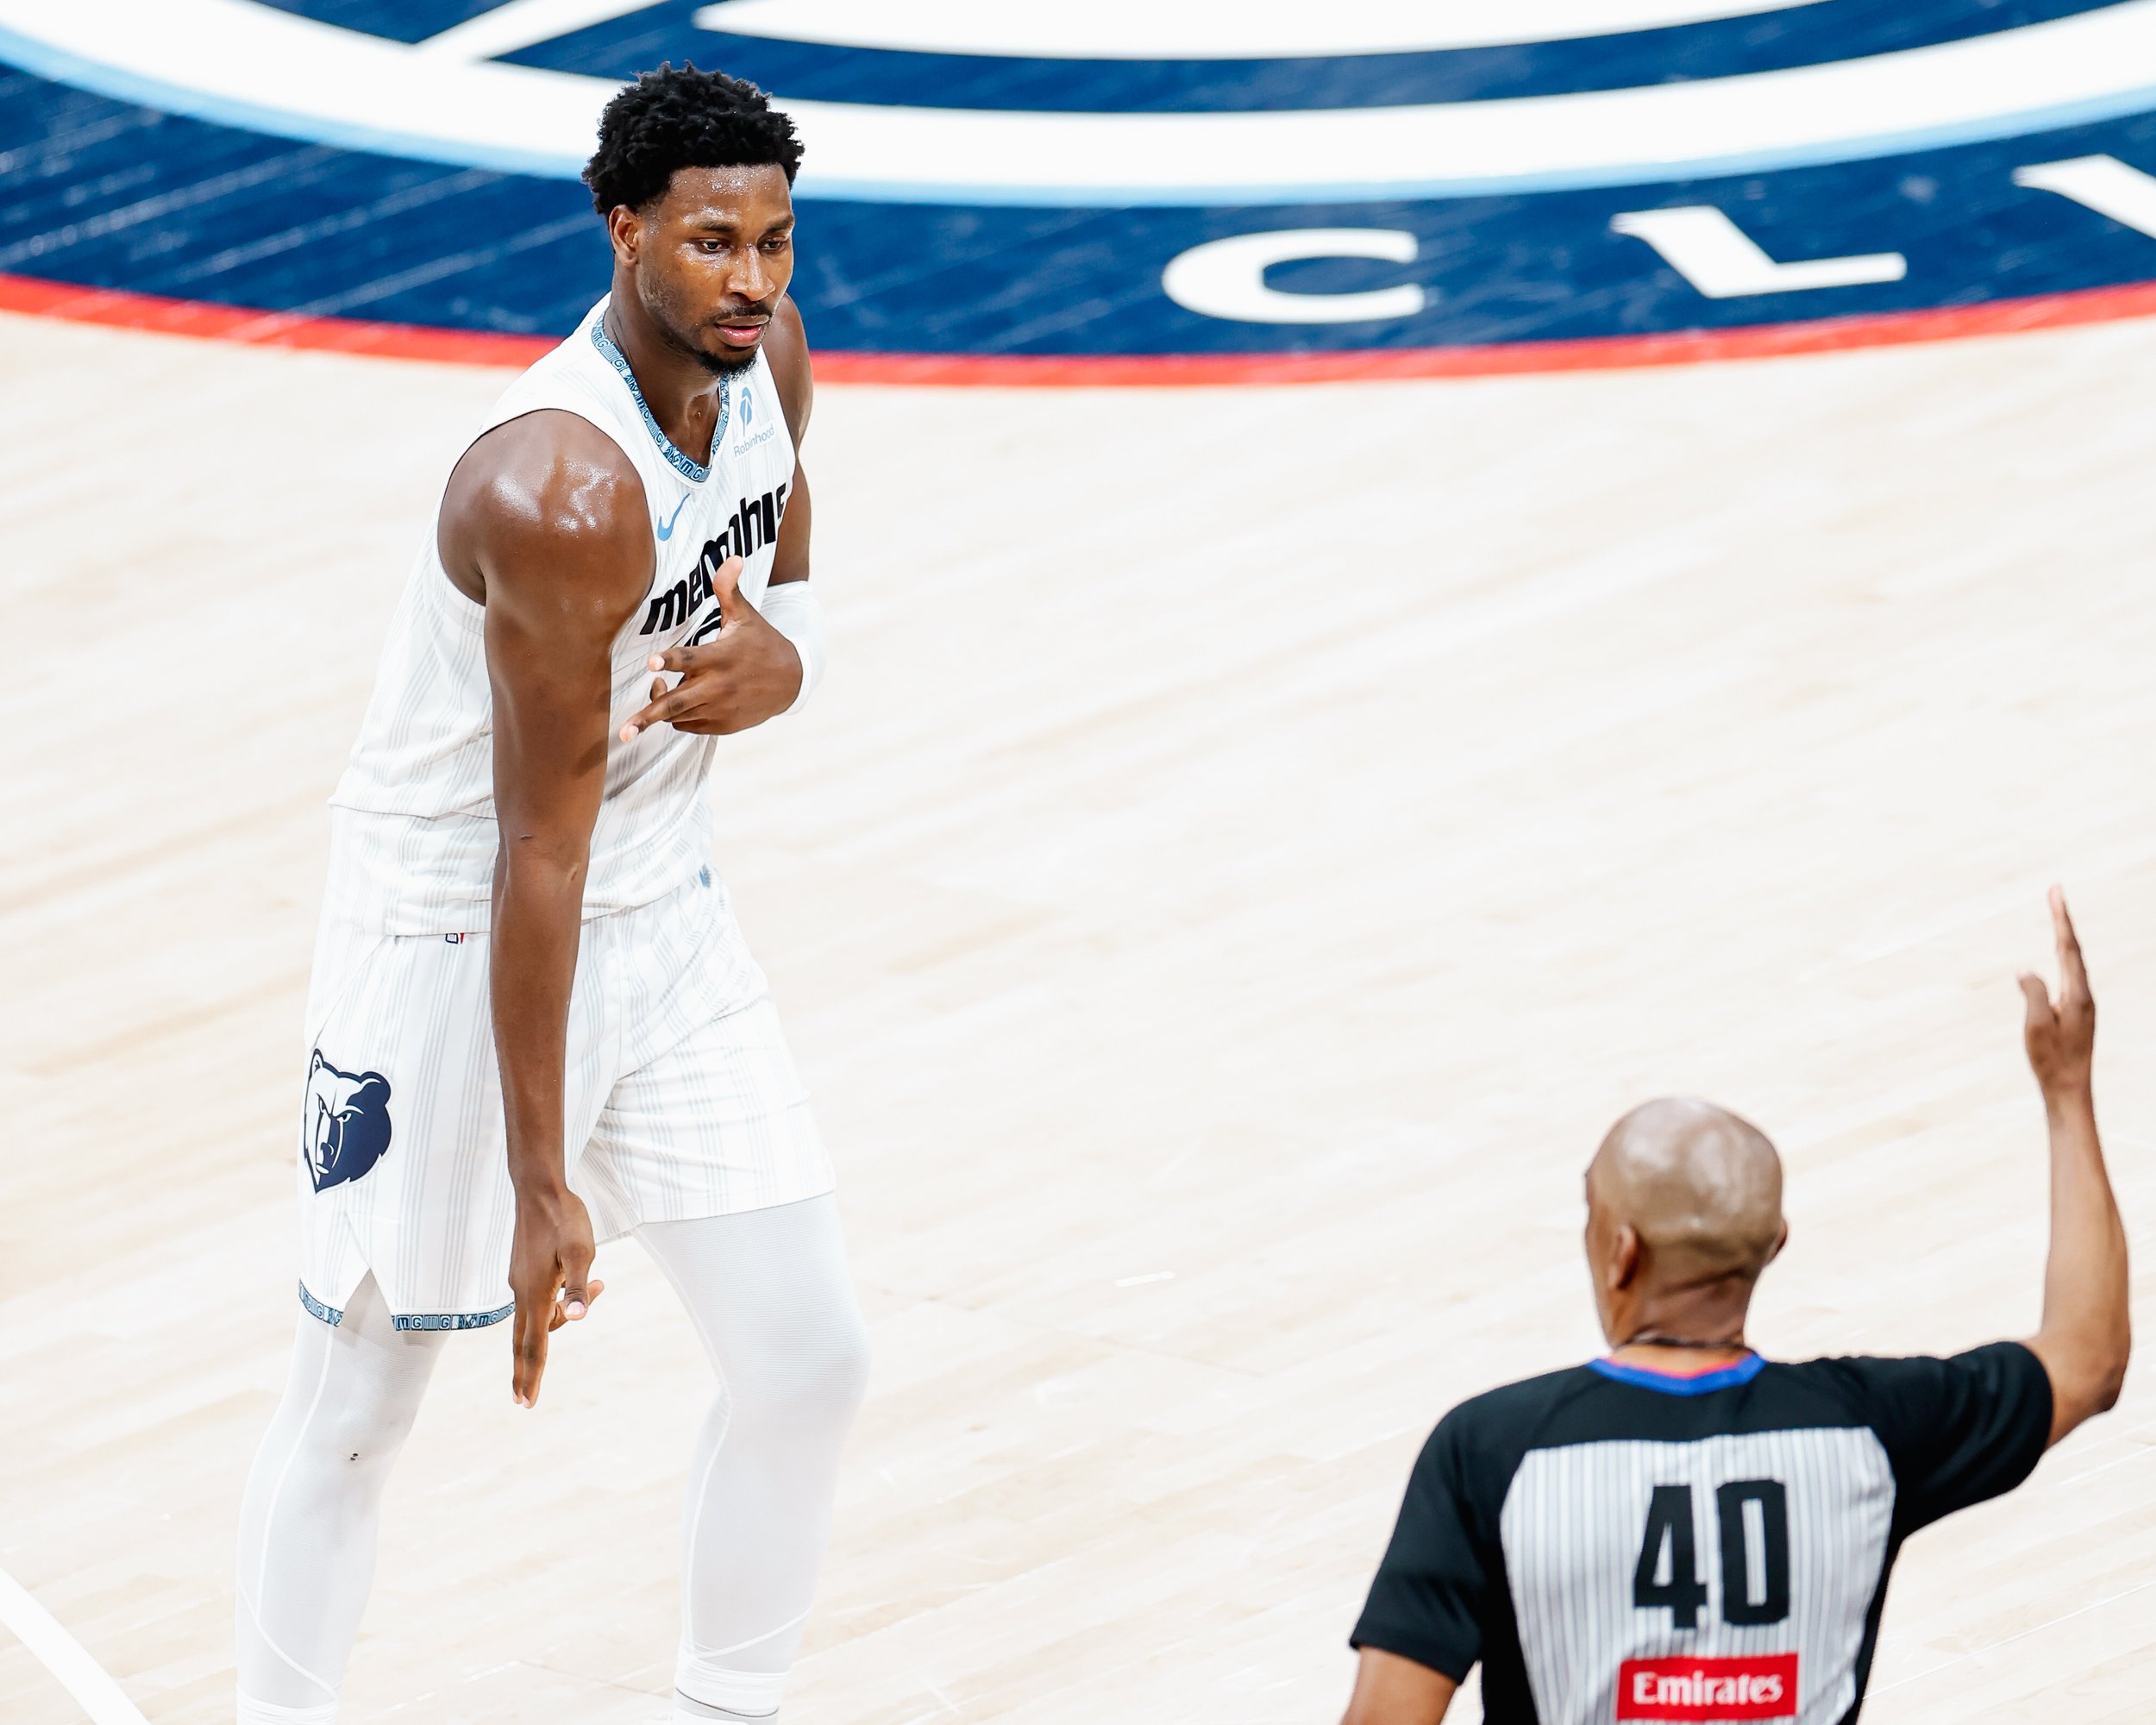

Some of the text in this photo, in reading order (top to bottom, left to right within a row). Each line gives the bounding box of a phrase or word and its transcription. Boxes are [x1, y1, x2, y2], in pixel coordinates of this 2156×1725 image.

[733, 423, 774, 458] Robinhood
[1633, 1478, 1790, 1630] 40
[1632, 1671, 1783, 1706] Emirates
